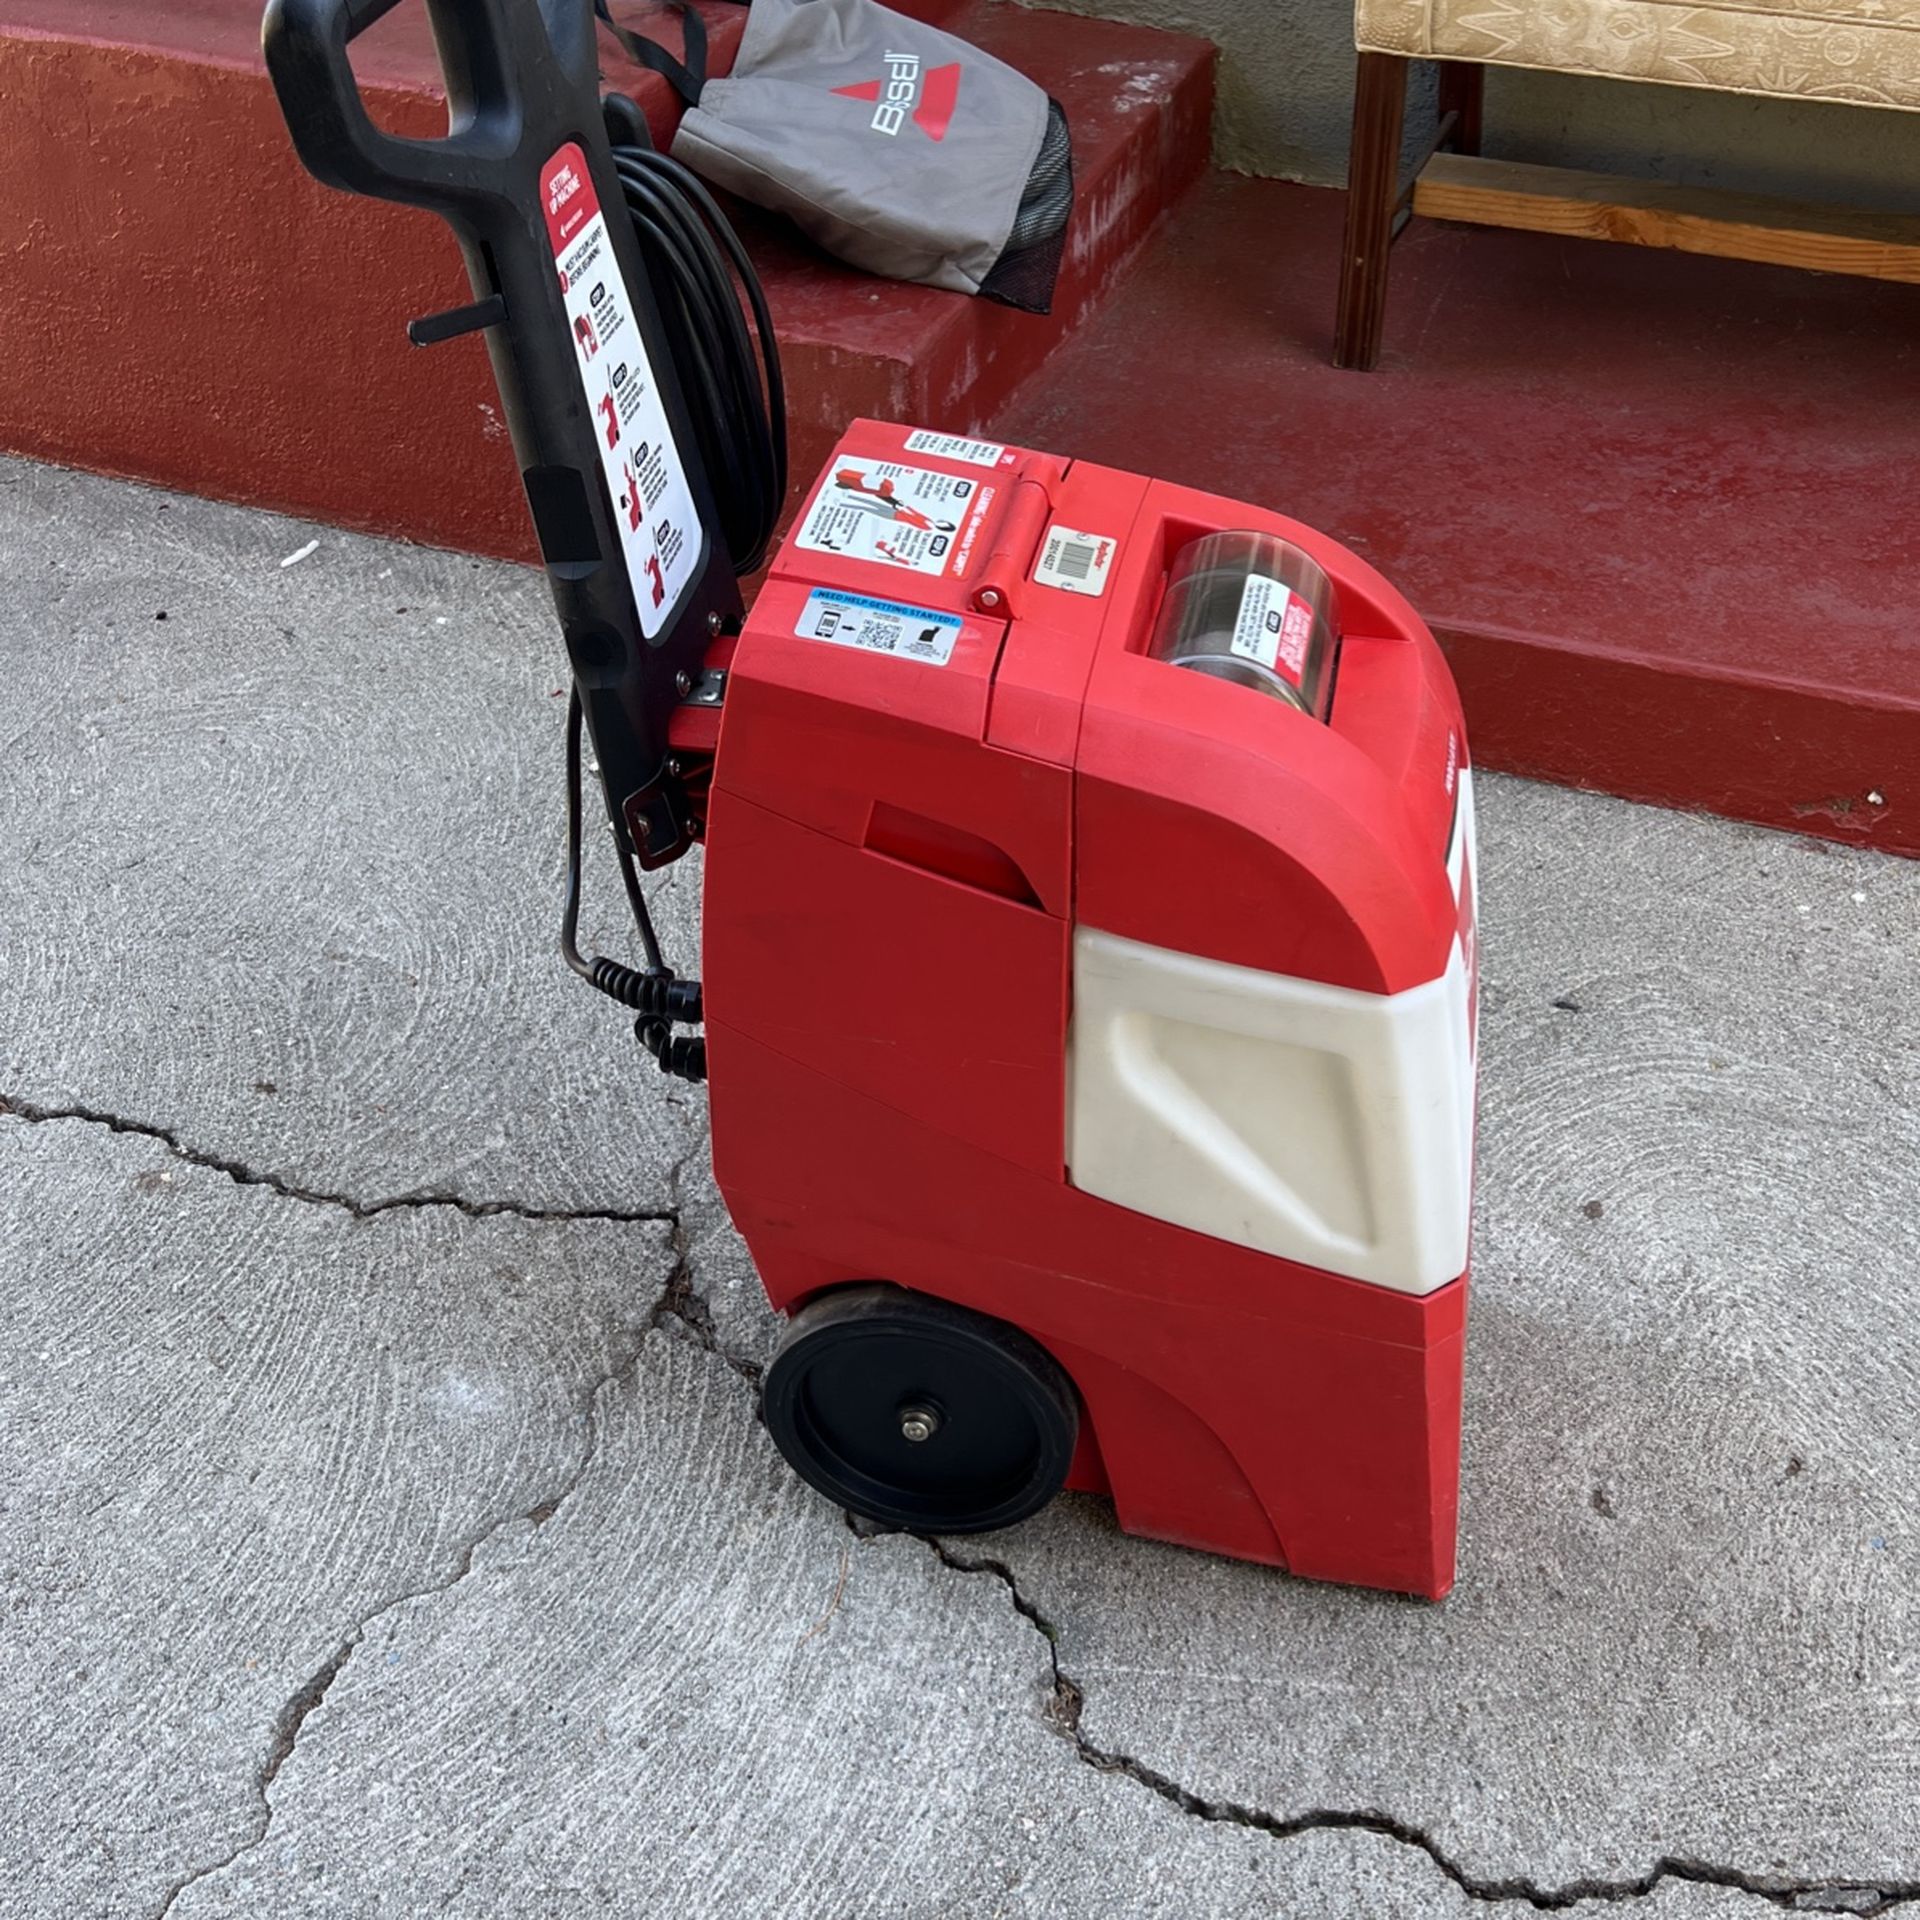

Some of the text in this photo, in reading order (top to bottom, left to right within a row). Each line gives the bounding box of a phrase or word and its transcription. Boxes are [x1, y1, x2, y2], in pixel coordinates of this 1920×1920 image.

[818, 590, 842, 601] NEED
[843, 594, 867, 607] HELP
[868, 599, 908, 615] GETTING
[910, 609, 956, 625] STARTED?
